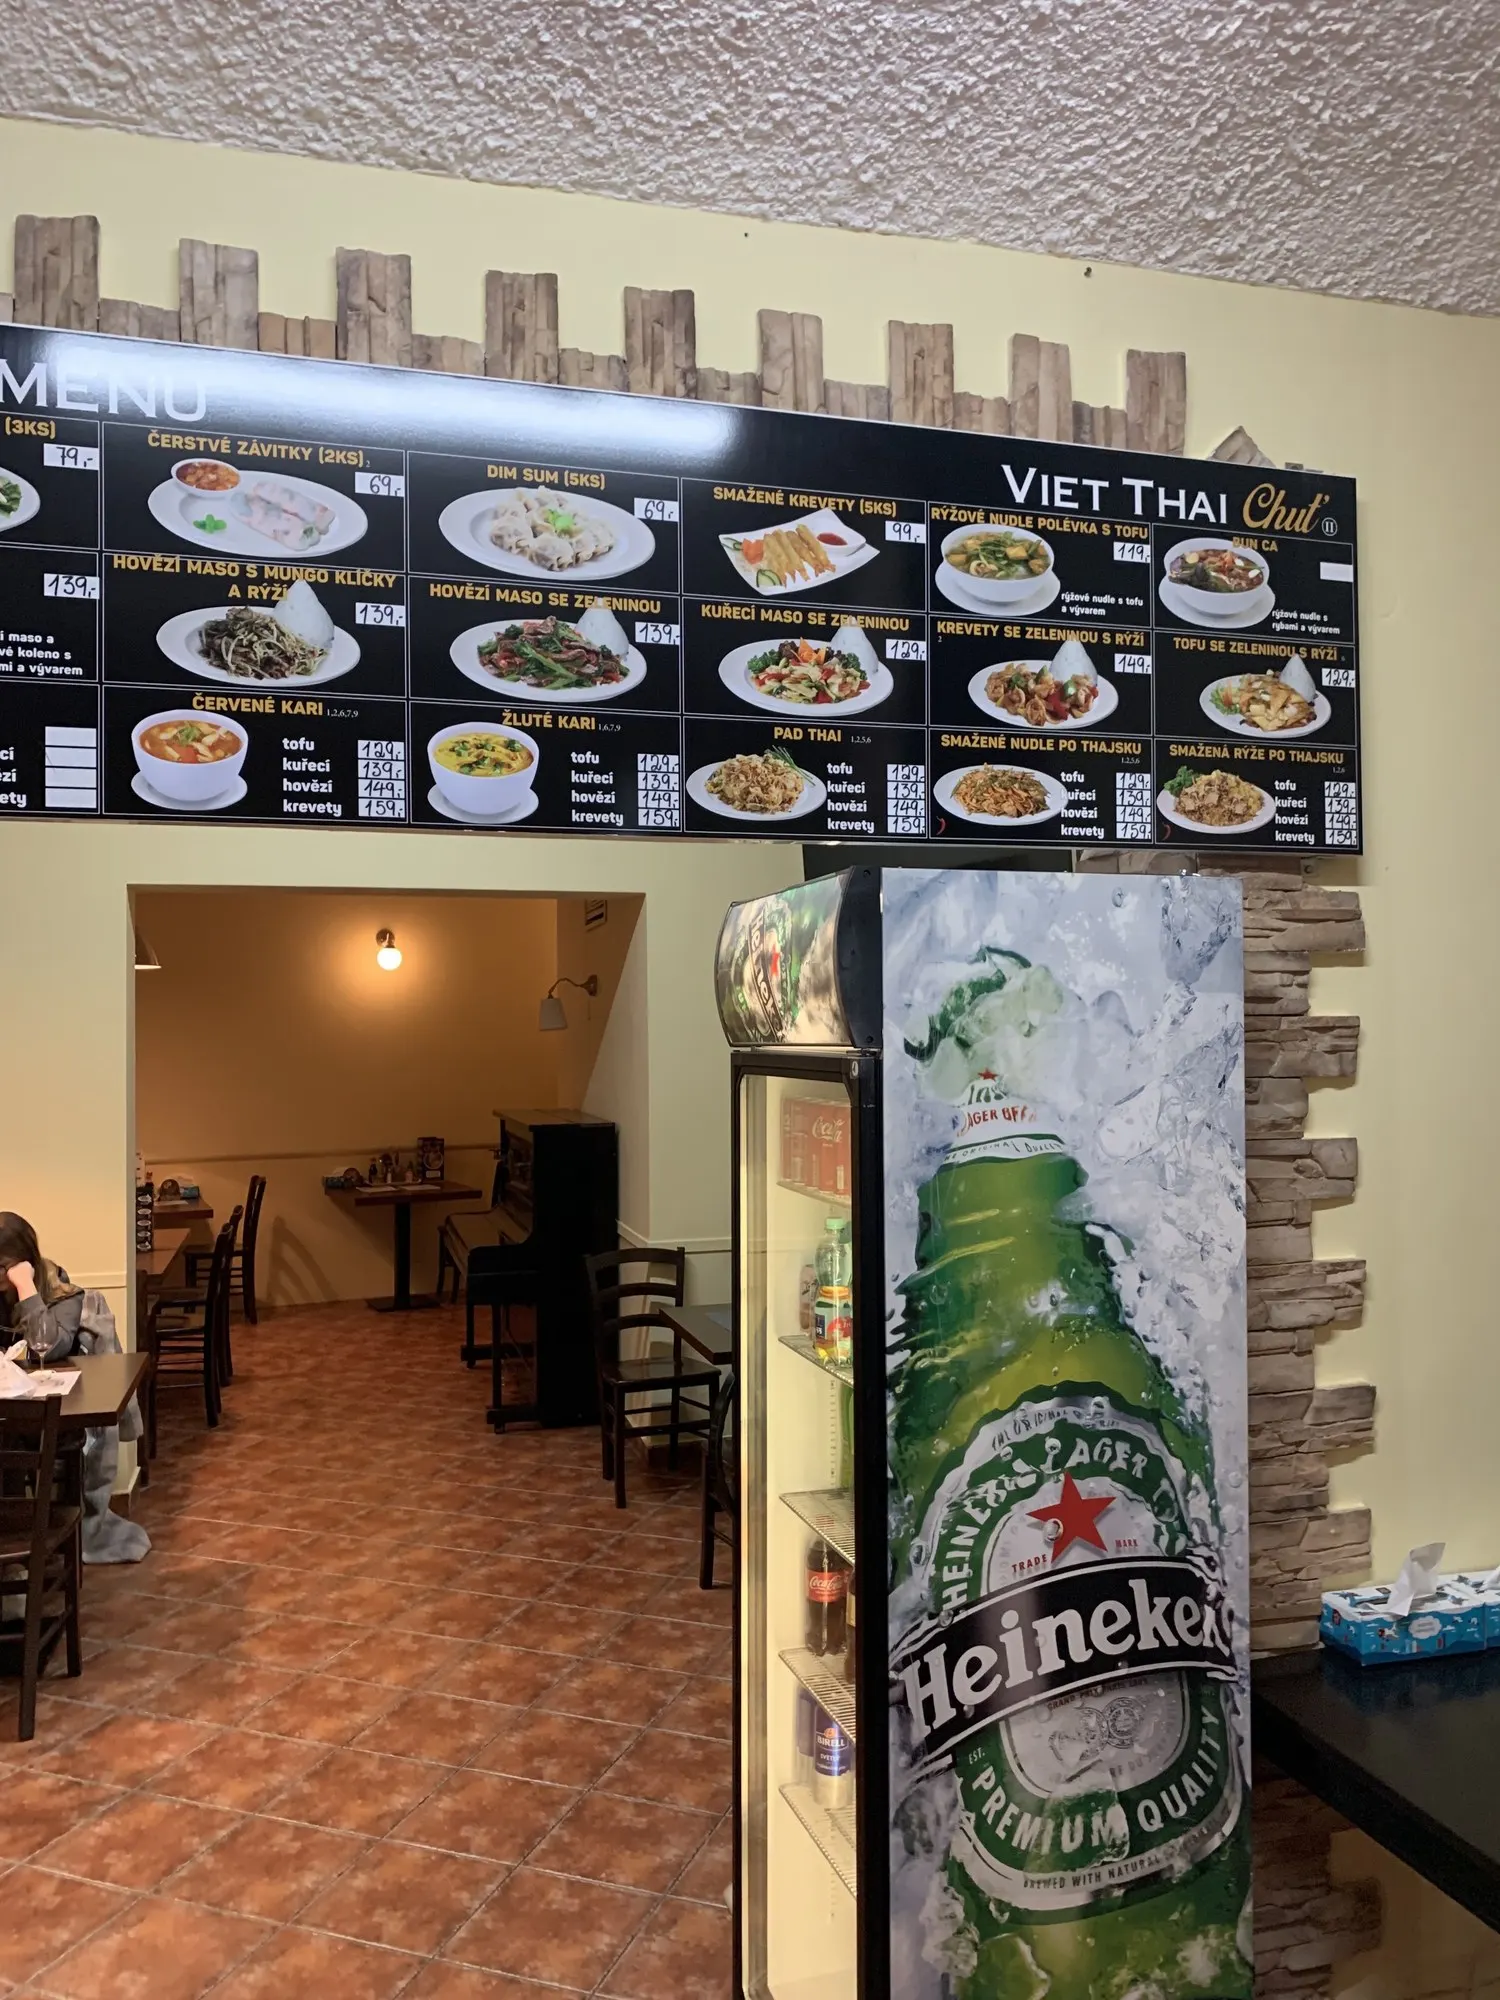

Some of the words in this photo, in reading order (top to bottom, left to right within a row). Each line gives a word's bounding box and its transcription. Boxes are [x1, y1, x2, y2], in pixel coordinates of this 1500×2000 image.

[0, 359, 206, 422] MENU
[5, 416, 56, 440] (3KS)
[147, 430, 231, 454] ČERSTVÉ
[237, 439, 313, 461] ZÁVITKY
[320, 447, 365, 467] (2KS)
[487, 465, 517, 480] DIM
[523, 468, 558, 485] SUM
[564, 471, 606, 490] (5KS)
[713, 486, 784, 505] SMAŽENÉ
[789, 494, 855, 512] KREVETY
[860, 498, 897, 517] (5KS)
[1001, 464, 1109, 511] VIET
[1122, 477, 1228, 524] THAI
[931, 506, 985, 524] RÝŽOVÉ
[989, 513, 1033, 529] NUDLE
[1038, 518, 1098, 535] POLÉVKA
[1101, 524, 1111, 536] S
[1114, 525, 1148, 539] TOFU
[112, 554, 181, 573] HOVĚZÍ
[187, 560, 240, 577] MASO
[246, 564, 258, 579] S
[264, 565, 329, 584] MUNGO
[335, 566, 396, 589] KLÍČKY
[227, 584, 243, 598] A
[247, 583, 288, 601] RÝŽÍ
[429, 583, 490, 601] HOVĚZÍ
[496, 589, 543, 605] MASO
[549, 592, 568, 607] SE
[574, 594, 661, 614] ZELENINOU
[1061, 592, 1090, 603] rýžové
[1092, 594, 1115, 604] nudle
[1118, 597, 1123, 605] s
[1126, 596, 1143, 607] tofu
[701, 602, 756, 621] KUŘECÍ
[760, 609, 803, 624] MASO
[807, 612, 826, 626] SE
[1061, 605, 1067, 613] a
[1069, 604, 1105, 616] vývarem
[937, 621, 999, 637] KREVETY
[1003, 626, 1021, 638] SE
[1025, 627, 1098, 643] ZELENINOU
[1102, 632, 1111, 644] S
[1115, 631, 1145, 646] RÝŽÍ
[1308, 624, 1340, 635] vývarem
[9, 633, 42, 643] maso
[46, 635, 54, 644] a
[18, 647, 60, 659] koleno
[64, 652, 71, 660] s
[1173, 637, 1205, 650] TOFU
[1209, 640, 1226, 652] SE
[1229, 642, 1296, 657] ZELENINOU
[1299, 647, 1307, 658] S
[1311, 645, 1338, 661] RÝŽÍ
[17, 664, 25, 673] a
[29, 663, 83, 676] vývarem
[192, 693, 275, 714] ČERVENÉ
[281, 698, 324, 716] KARI
[502, 709, 553, 728] ŽLUTÉ
[558, 716, 596, 730] KARI
[773, 727, 803, 740] PAD
[808, 729, 842, 742] THAI
[283, 737, 315, 752] tofu
[941, 732, 1006, 749] SMAŽENÉ
[1011, 738, 1054, 751] NUDLE
[1058, 740, 1077, 751] PO
[1081, 740, 1142, 754] THAJSKU
[571, 752, 599, 765] tofu
[1169, 743, 1230, 758] SMAŽENÁ
[1234, 745, 1265, 760] RÝŽE
[1269, 750, 1285, 761] PO
[1289, 751, 1344, 764] THAJSKU
[283, 757, 330, 772] kuřecí
[827, 763, 853, 775] tofu
[571, 770, 613, 785] kuřecí
[1060, 771, 1084, 783] tofu
[283, 778, 333, 793] hovězí
[827, 780, 865, 794] kuřecí
[1275, 780, 1296, 791] tofu
[571, 790, 615, 804] hovězí
[1275, 796, 1307, 808] kuřecí
[283, 800, 342, 817] krevety
[827, 800, 867, 813] hovězí
[1060, 807, 1098, 818] hovězí
[571, 810, 624, 827] krevety
[827, 818, 875, 834] krevety
[1275, 813, 1308, 825] hovězí
[1060, 824, 1104, 839] krevety
[1275, 830, 1315, 845] krevety
[1115, 1539, 1138, 1548] MARK
[1011, 1554, 1048, 1573] TRADE
[817, 1735, 845, 1747] BIRELL
[968, 1747, 985, 1764] EST.
[1137, 1705, 1219, 1832] QUALITY
[1072, 1872, 1101, 1886] WITH
